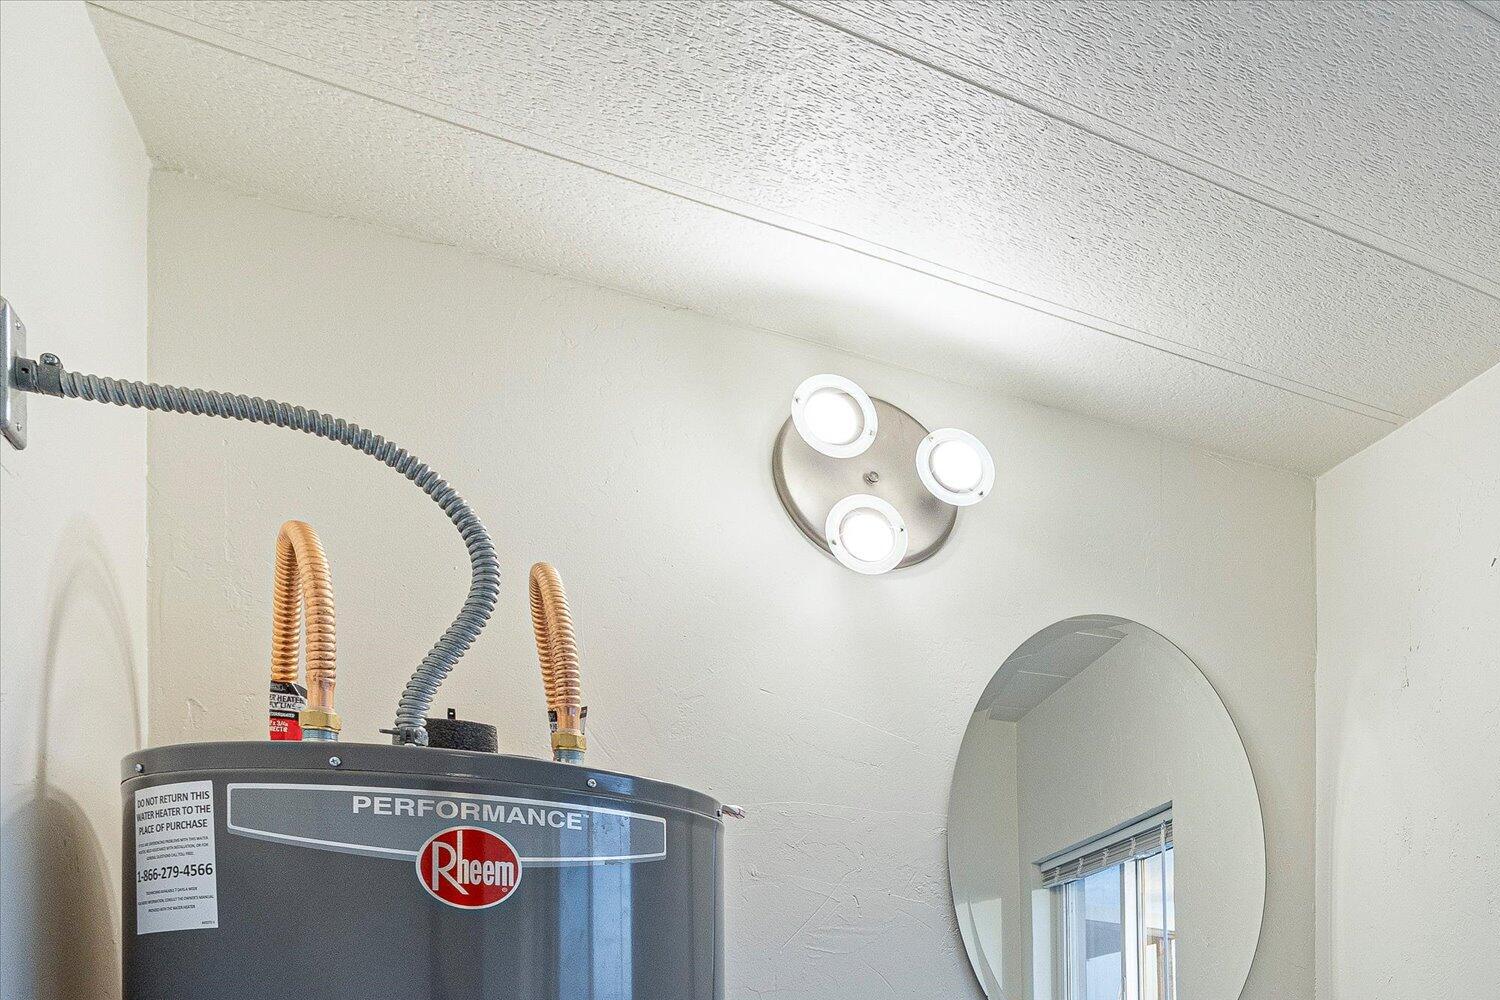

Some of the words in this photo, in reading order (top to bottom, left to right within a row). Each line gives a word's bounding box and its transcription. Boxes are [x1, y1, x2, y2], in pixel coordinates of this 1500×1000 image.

[137, 799, 144, 808] DO
[146, 796, 158, 806] NOT
[160, 792, 188, 804] RETURN
[190, 791, 210, 800] THIS
[137, 811, 154, 822] WATER
[155, 807, 180, 818] HEATER
[182, 806, 193, 815] TO
[194, 804, 211, 813] THE
[352, 795, 582, 831] PERFORMANCE
[139, 825, 154, 835] PLACE
[155, 824, 164, 832] OF
[166, 819, 208, 831] PURCHASE
[432, 830, 514, 895] Rheem
[137, 863, 213, 883] 1-866-279-4566
